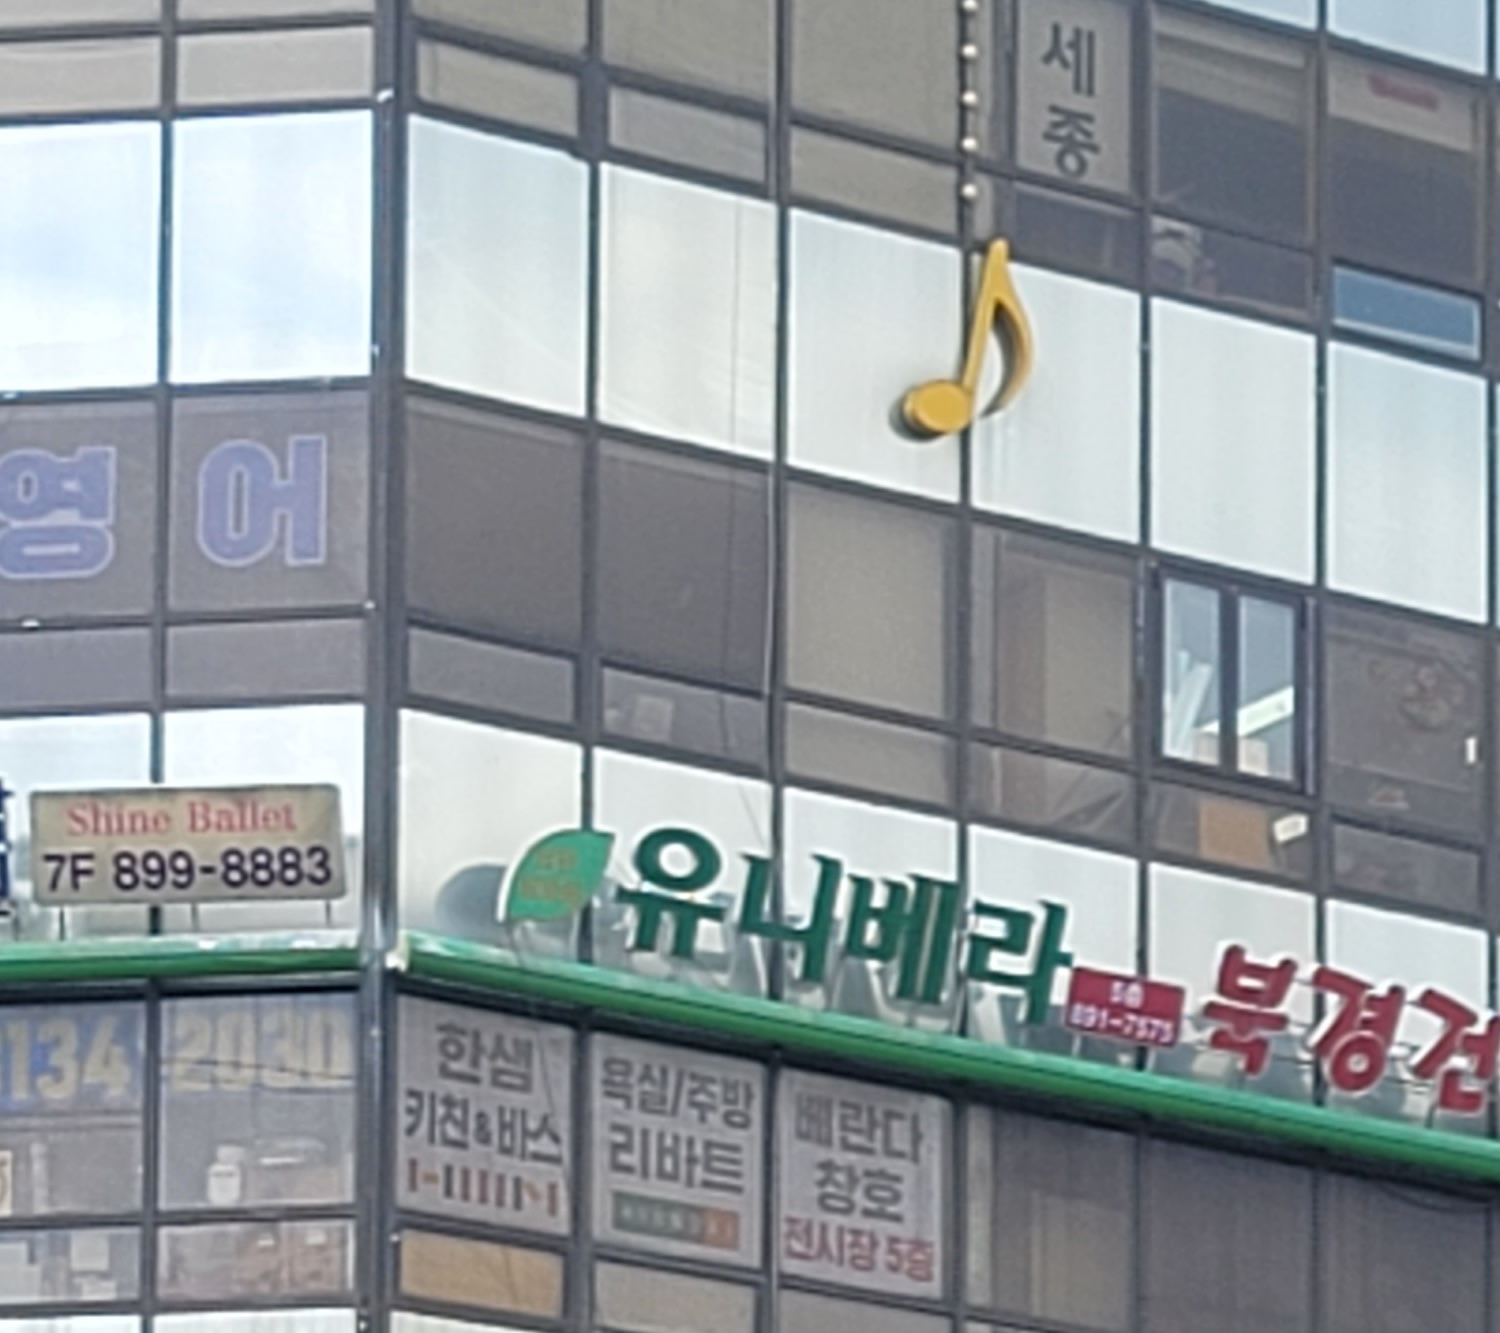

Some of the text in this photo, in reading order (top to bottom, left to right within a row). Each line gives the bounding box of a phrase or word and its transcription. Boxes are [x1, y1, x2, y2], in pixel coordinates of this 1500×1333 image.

[66, 800, 296, 836] Shine Ballet
[43, 847, 332, 891] 7F 899-8883
[616, 828, 1073, 1025] 유니베라
[435, 1020, 534, 1094] 한샘
[608, 1123, 747, 1194] 리바트
[795, 1099, 923, 1163] 베란다
[816, 1157, 905, 1224] 창호
[783, 1215, 877, 1275] 전시장
